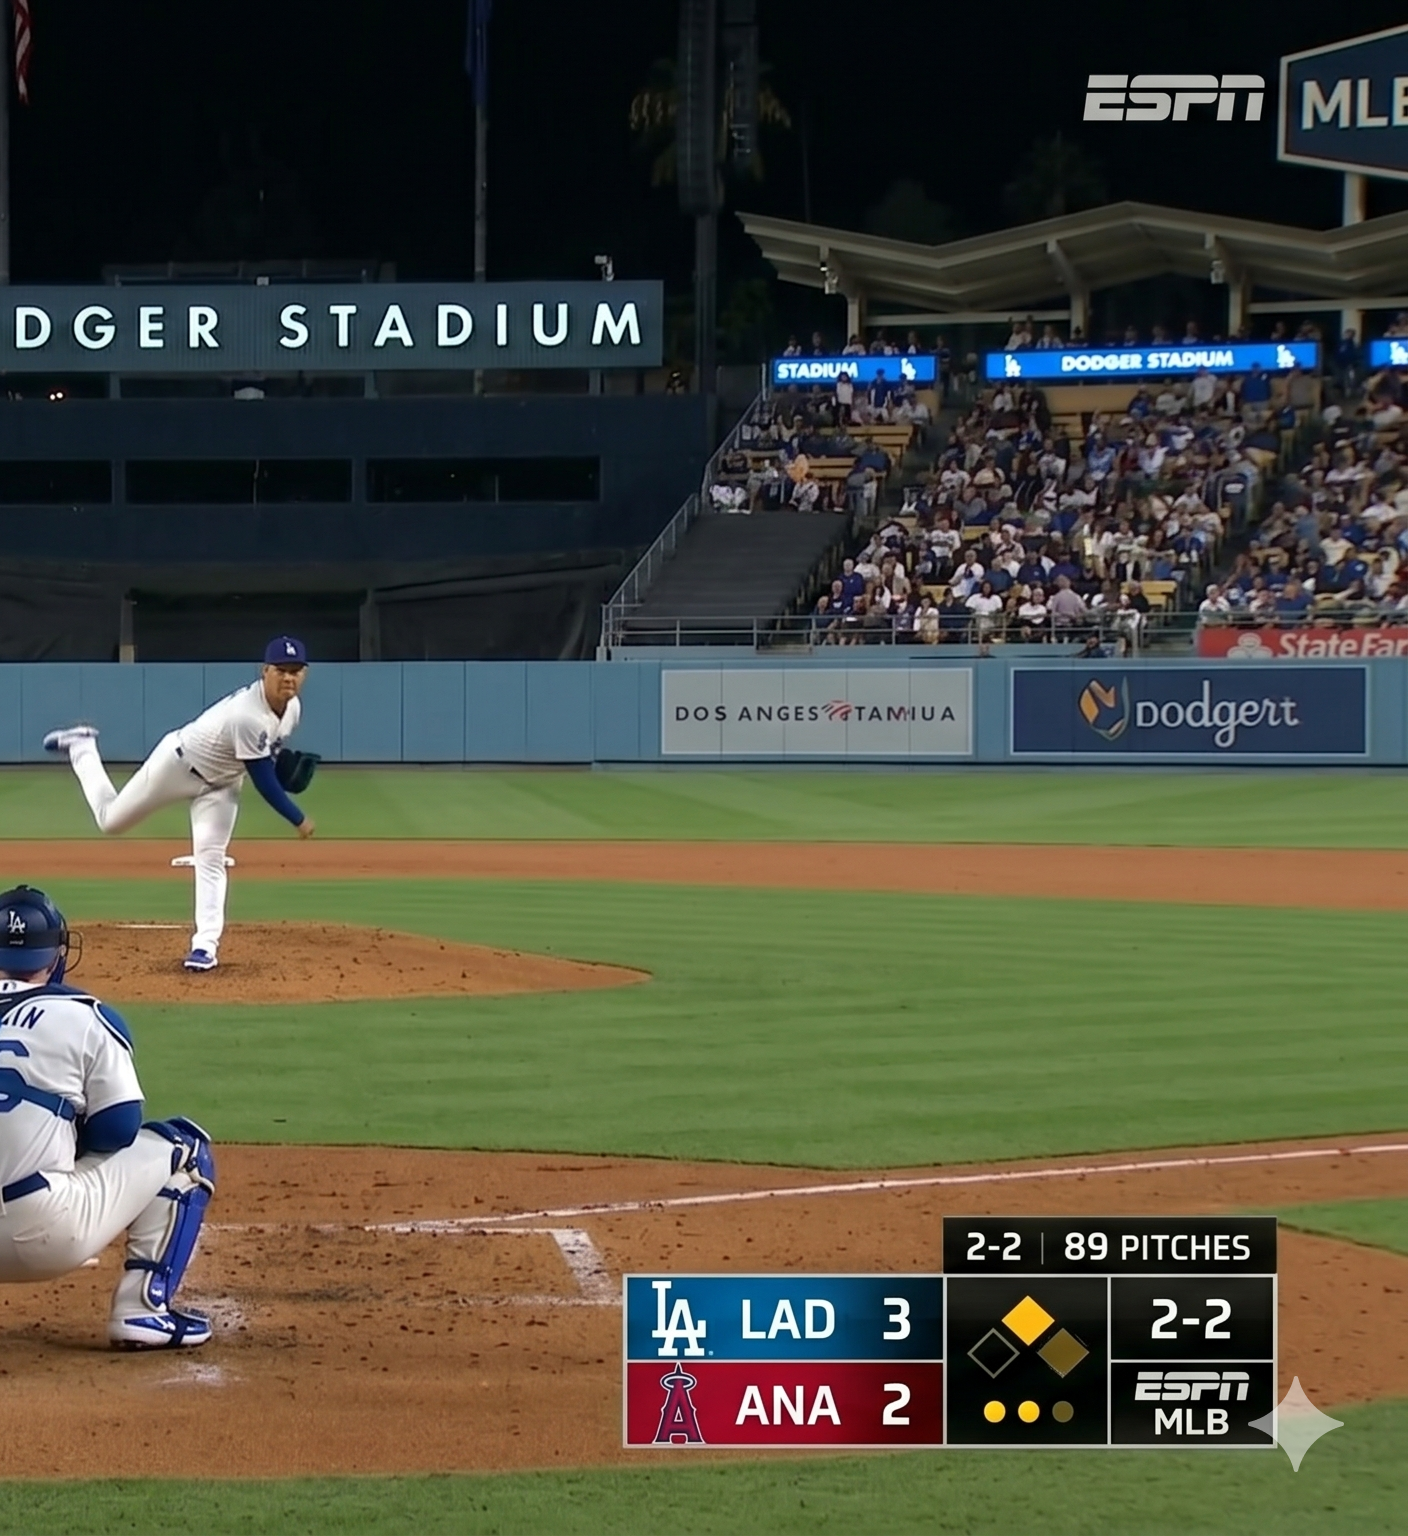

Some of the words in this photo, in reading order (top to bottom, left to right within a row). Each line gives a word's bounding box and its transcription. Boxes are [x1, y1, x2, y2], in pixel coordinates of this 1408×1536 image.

[279, 302, 641, 348] STADIUM
[777, 362, 859, 379] STADIUM
[1061, 353, 1142, 372] DODGER
[1147, 350, 1234, 368] STADIUM
[1277, 632, 1359, 659] State
[675, 705, 727, 722] DOS
[738, 706, 819, 722] ANGES
